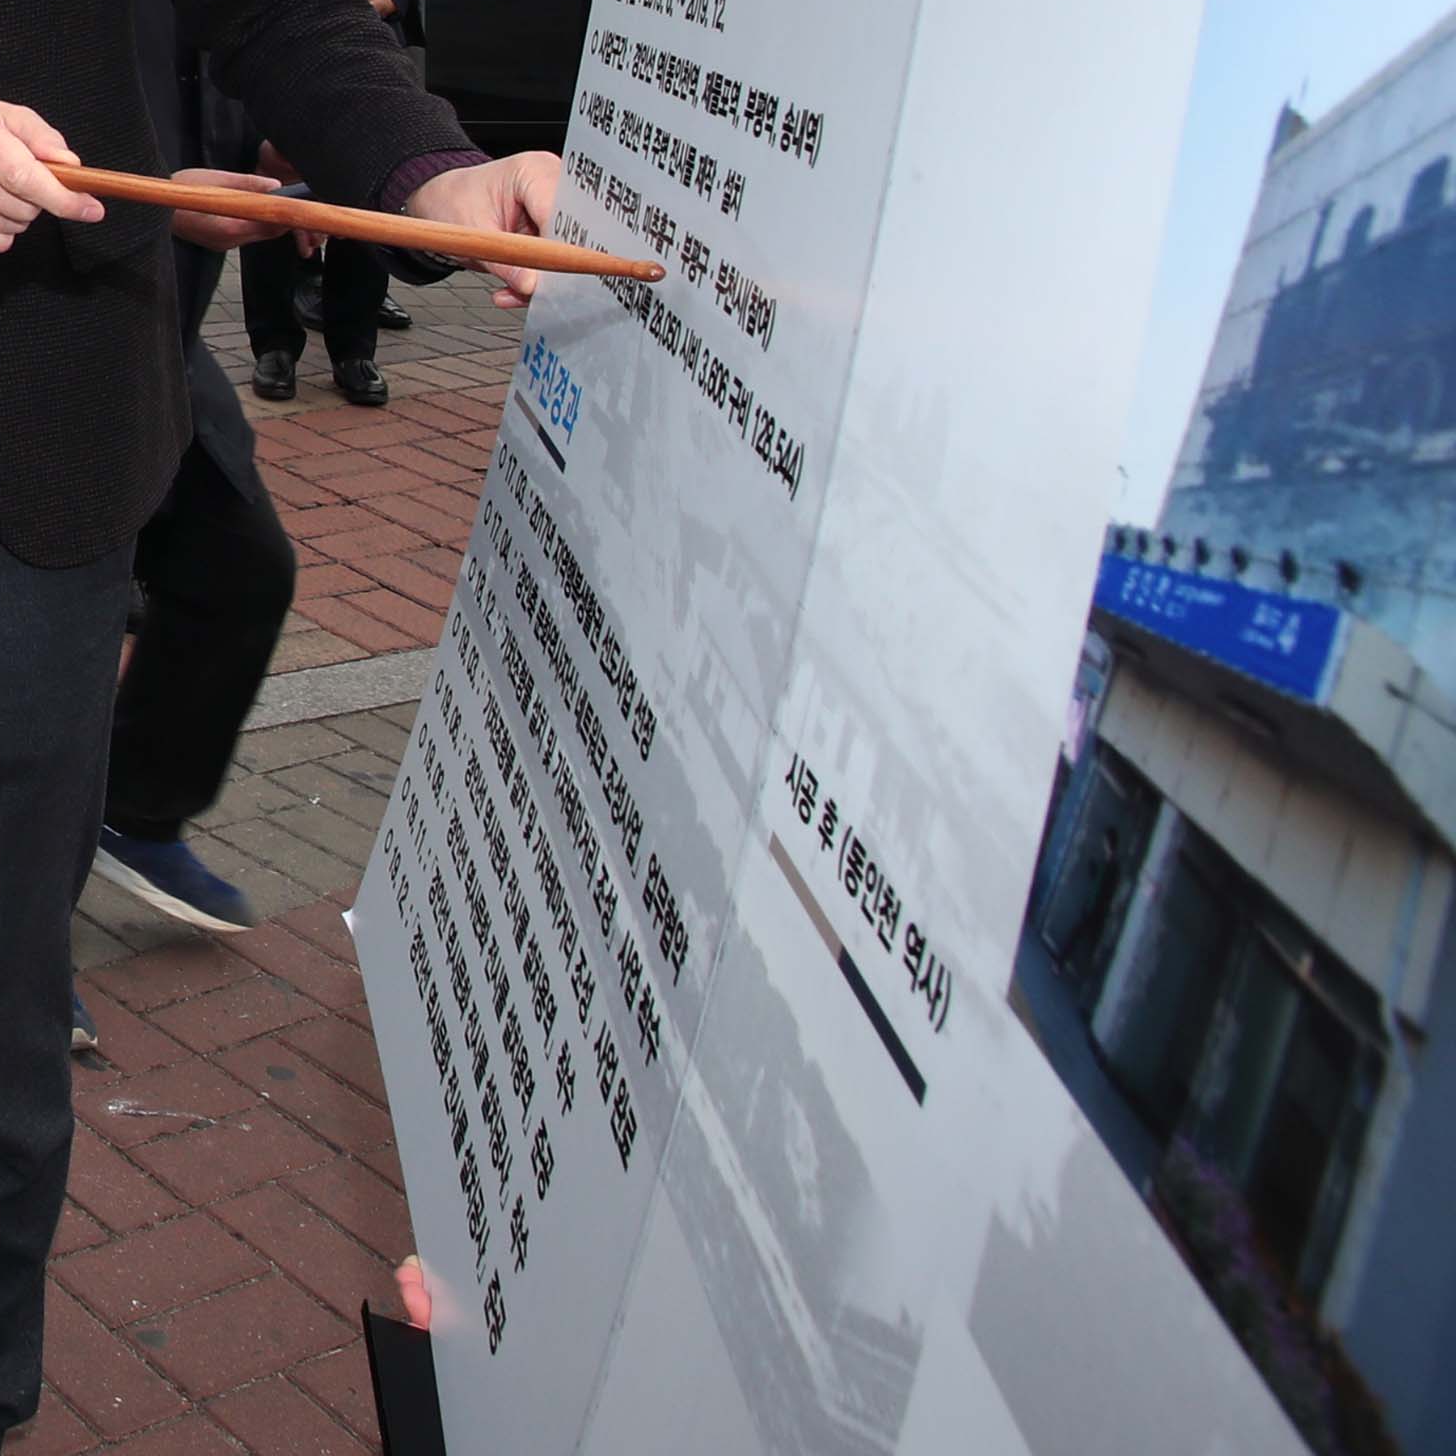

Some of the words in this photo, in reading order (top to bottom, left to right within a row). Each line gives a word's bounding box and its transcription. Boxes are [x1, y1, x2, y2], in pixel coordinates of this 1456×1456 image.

[585, 91, 616, 136] 사업내용
[617, 108, 644, 153] 경인선
[641, 120, 654, 160] 역
[650, 126, 671, 171] 주변
[667, 137, 697, 188] 전시물
[693, 153, 718, 202] 제작
[719, 168, 746, 222] 설치
[597, 29, 629, 71] 사업구간
[630, 41, 658, 84] 경인선
[700, 70, 742, 127] 제물포역,
[742, 86, 779, 147] 부평역,
[779, 102, 824, 168] 송내역)
[573, 151, 603, 200] 추진주체
[641, 204, 677, 258] 미추홀구
[679, 231, 711, 288] 부평구
[714, 259, 777, 351] 부천시(참여)
[529, 335, 583, 445] 추진경과
[648, 297, 682, 356] 28,050
[678, 327, 702, 382] 시비
[697, 347, 730, 409] 3,606
[727, 375, 754, 440] 구비
[750, 404, 805, 500] 128,544)
[528, 494, 557, 559] 2017년
[551, 535, 605, 652] 지역행복생활권
[598, 625, 638, 721] 선도사업
[630, 692, 657, 762] 선정
[527, 693, 549, 753] 설치
[541, 726, 558, 774] 및
[551, 751, 600, 888] 기차테마거리
[616, 930, 643, 1012] 사업
[636, 983, 660, 1066] 착수
[532, 598, 579, 710] 문화역사자산
[641, 853, 689, 986] 업무협약
[784, 752, 819, 825] 시공
[817, 797, 839, 852] 후
[837, 825, 902, 955] (동인천
[903, 922, 953, 1035] 역사)
[508, 765, 530, 825] 설치
[521, 799, 538, 848] 및
[531, 826, 578, 971] 기차테마거리
[592, 1020, 619, 1105] 사업
[609, 1077, 637, 1172] 완료
[425, 980, 452, 1085] 역사문화
[443, 1065, 469, 1159] 전시물
[482, 1268, 506, 1355] 준공
